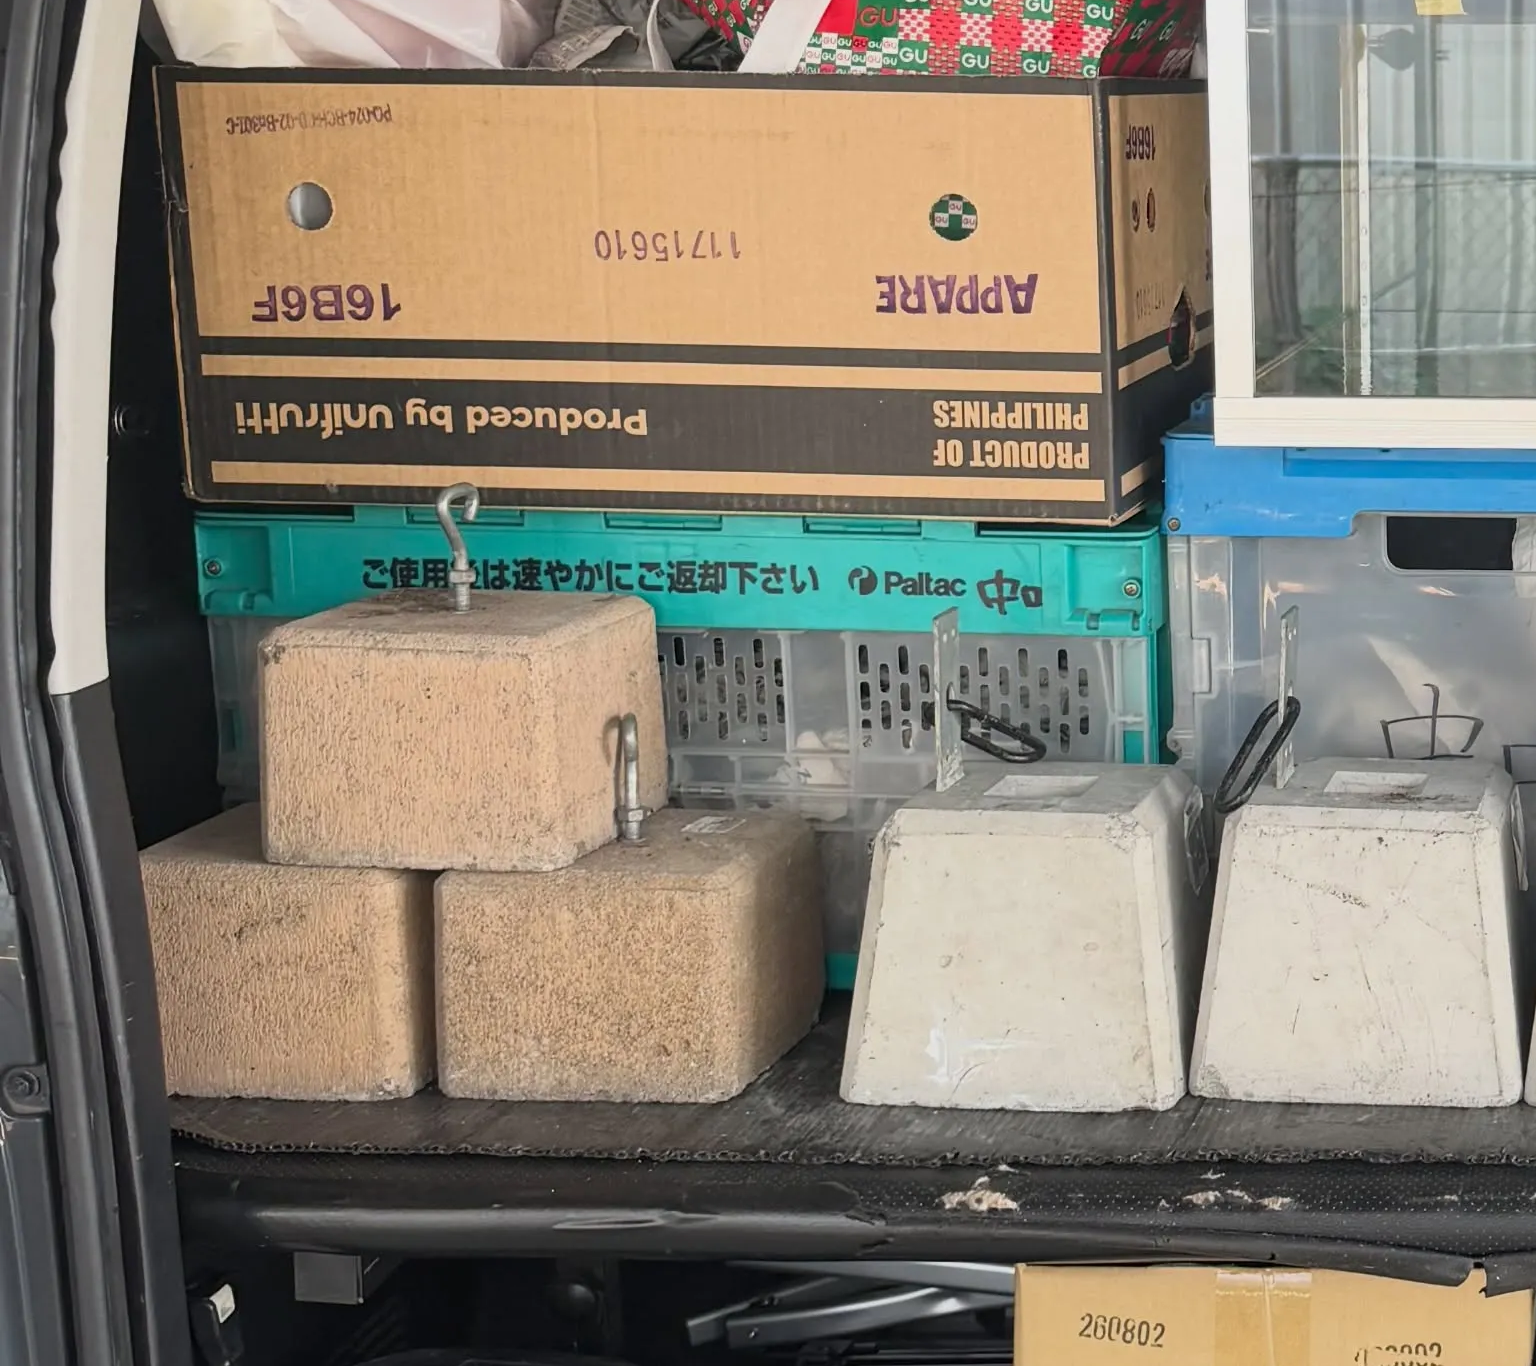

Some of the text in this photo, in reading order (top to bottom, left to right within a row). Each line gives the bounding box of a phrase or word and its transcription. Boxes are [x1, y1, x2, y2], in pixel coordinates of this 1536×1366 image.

[860, 7, 898, 27] GU
[1087, 3, 1114, 21] GU
[838, 38, 852, 47] GU
[822, 52, 835, 61] GU
[852, 54, 866, 63] GU
[883, 57, 897, 66] GU
[900, 47, 928, 64] GU
[961, 53, 991, 69] GU
[1022, 57, 1050, 75] GU
[594, 228, 743, 264] 11715610
[251, 280, 403, 323] 16B6F
[874, 272, 1039, 316] APPARE
[235, 398, 648, 439] Produced by Unifrutti
[932, 398, 1090, 432] PHILIPPINES
[932, 438, 1090, 469] PRODUCT OF
[884, 571, 967, 596] Paltac
[1078, 1312, 1167, 1349] 260802
